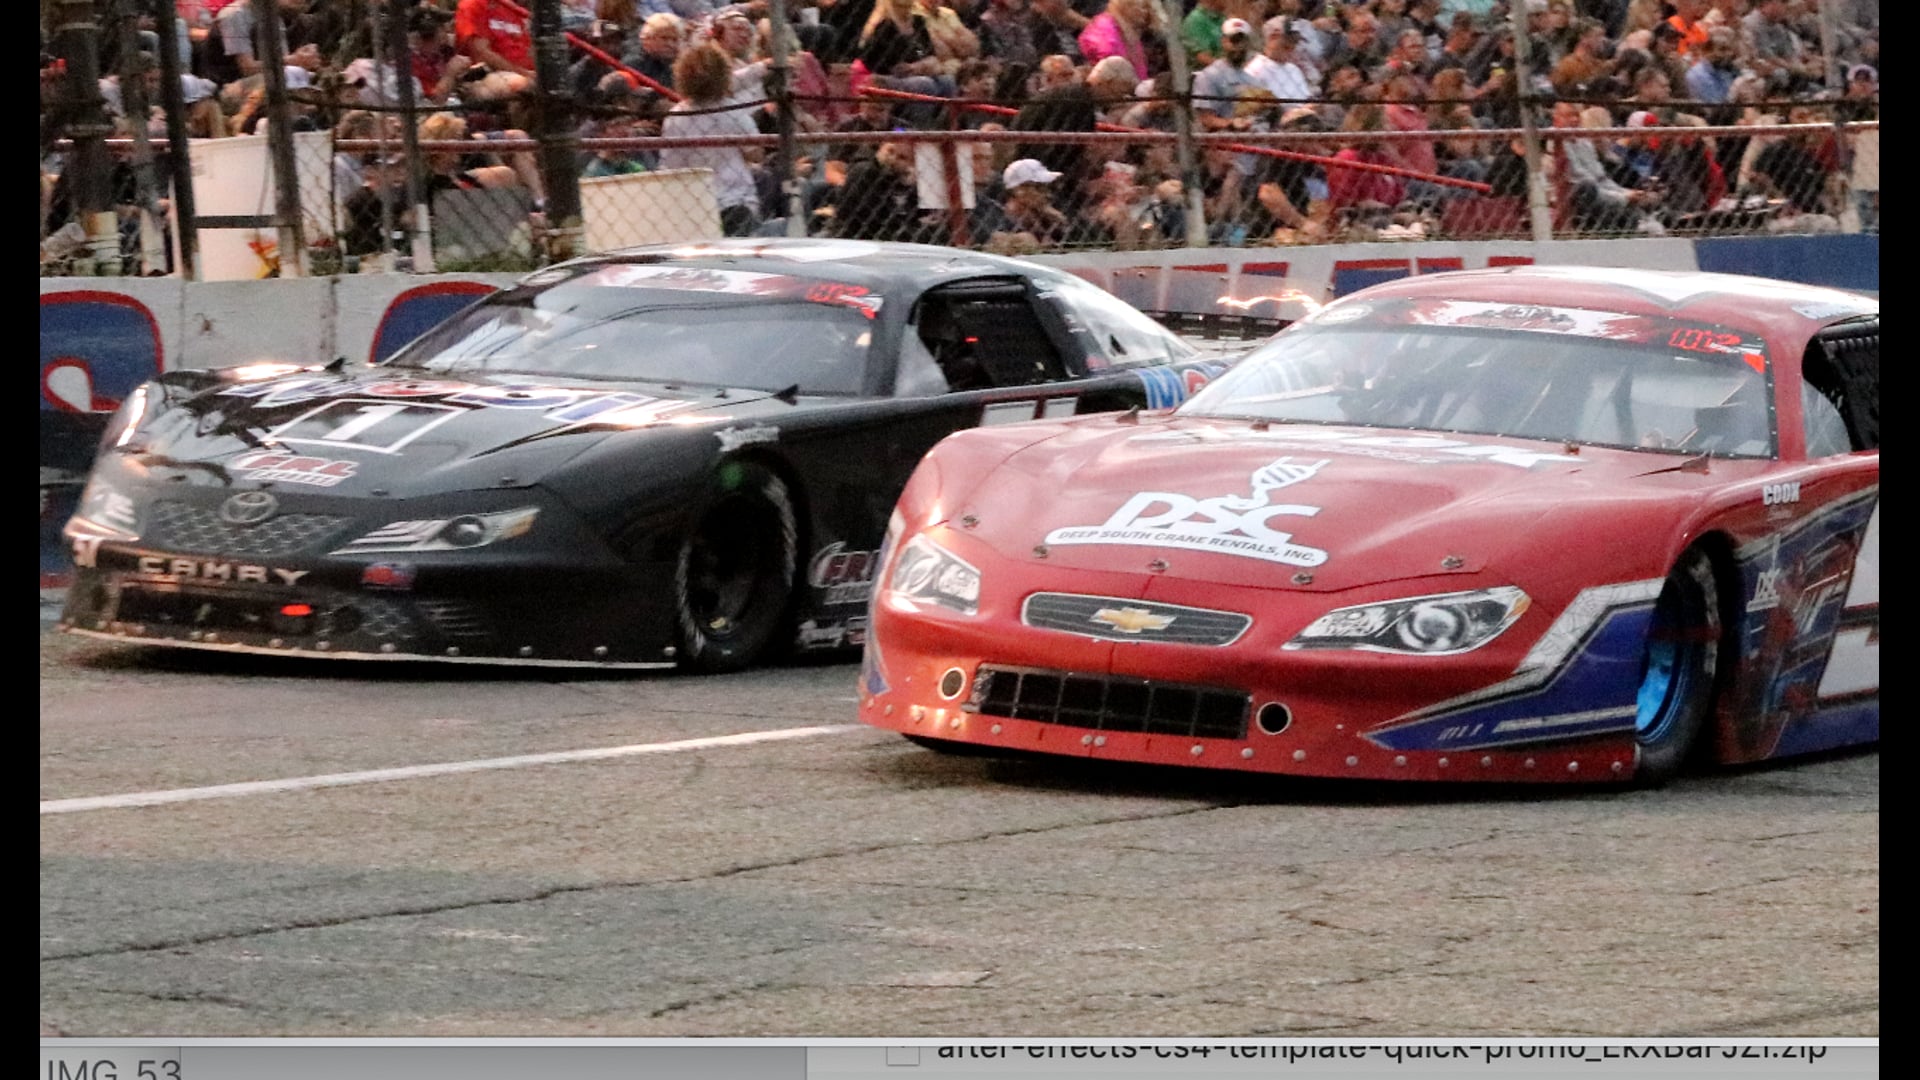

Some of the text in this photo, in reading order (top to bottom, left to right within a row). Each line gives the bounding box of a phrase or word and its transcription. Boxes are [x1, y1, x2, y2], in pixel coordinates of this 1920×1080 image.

[322, 405, 410, 441] 1
[1099, 491, 1321, 542] DSC
[1057, 529, 1316, 562] DEEP SOUTH CRANE RENTALS, INC.
[138, 556, 310, 586] CAMRY
